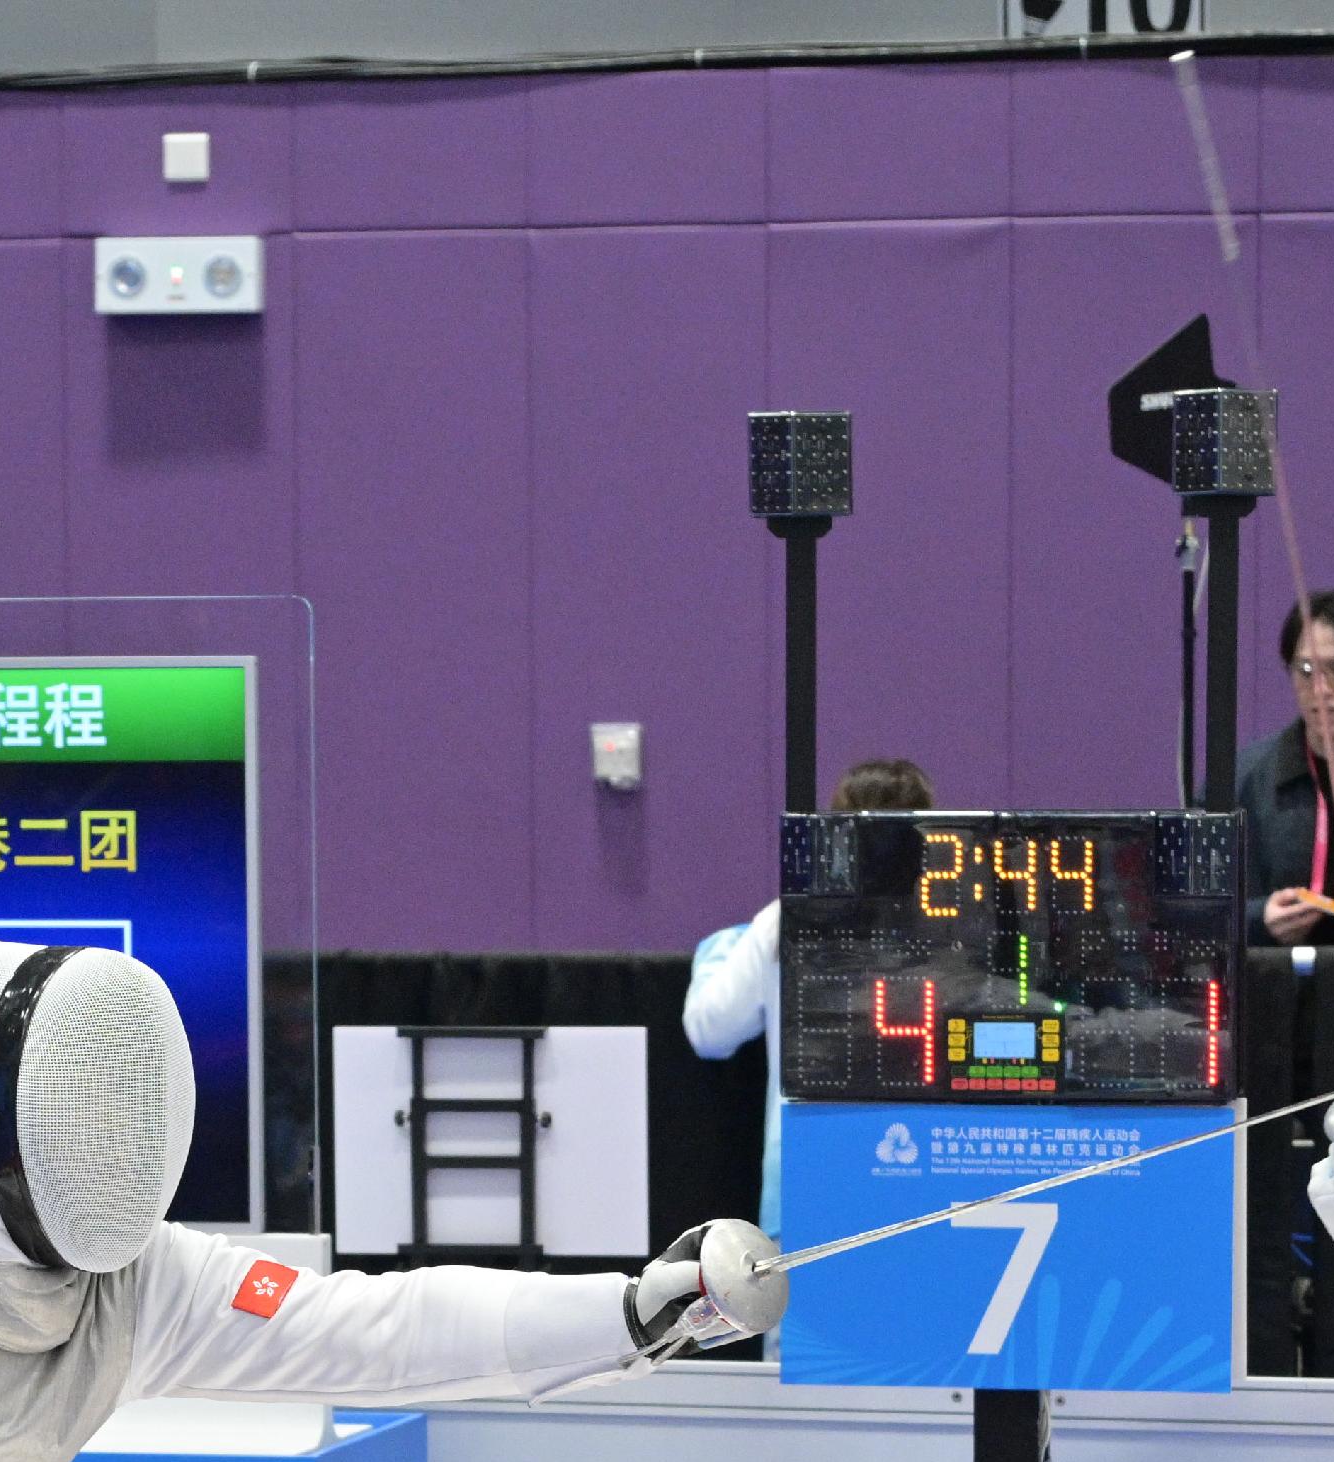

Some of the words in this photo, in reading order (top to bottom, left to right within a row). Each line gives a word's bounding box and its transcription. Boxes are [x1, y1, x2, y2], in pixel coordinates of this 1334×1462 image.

[920, 834, 1094, 917] 2:44
[874, 979, 935, 1084] 4
[1207, 980, 1219, 1086] 1
[950, 1200, 1059, 1356] 7
